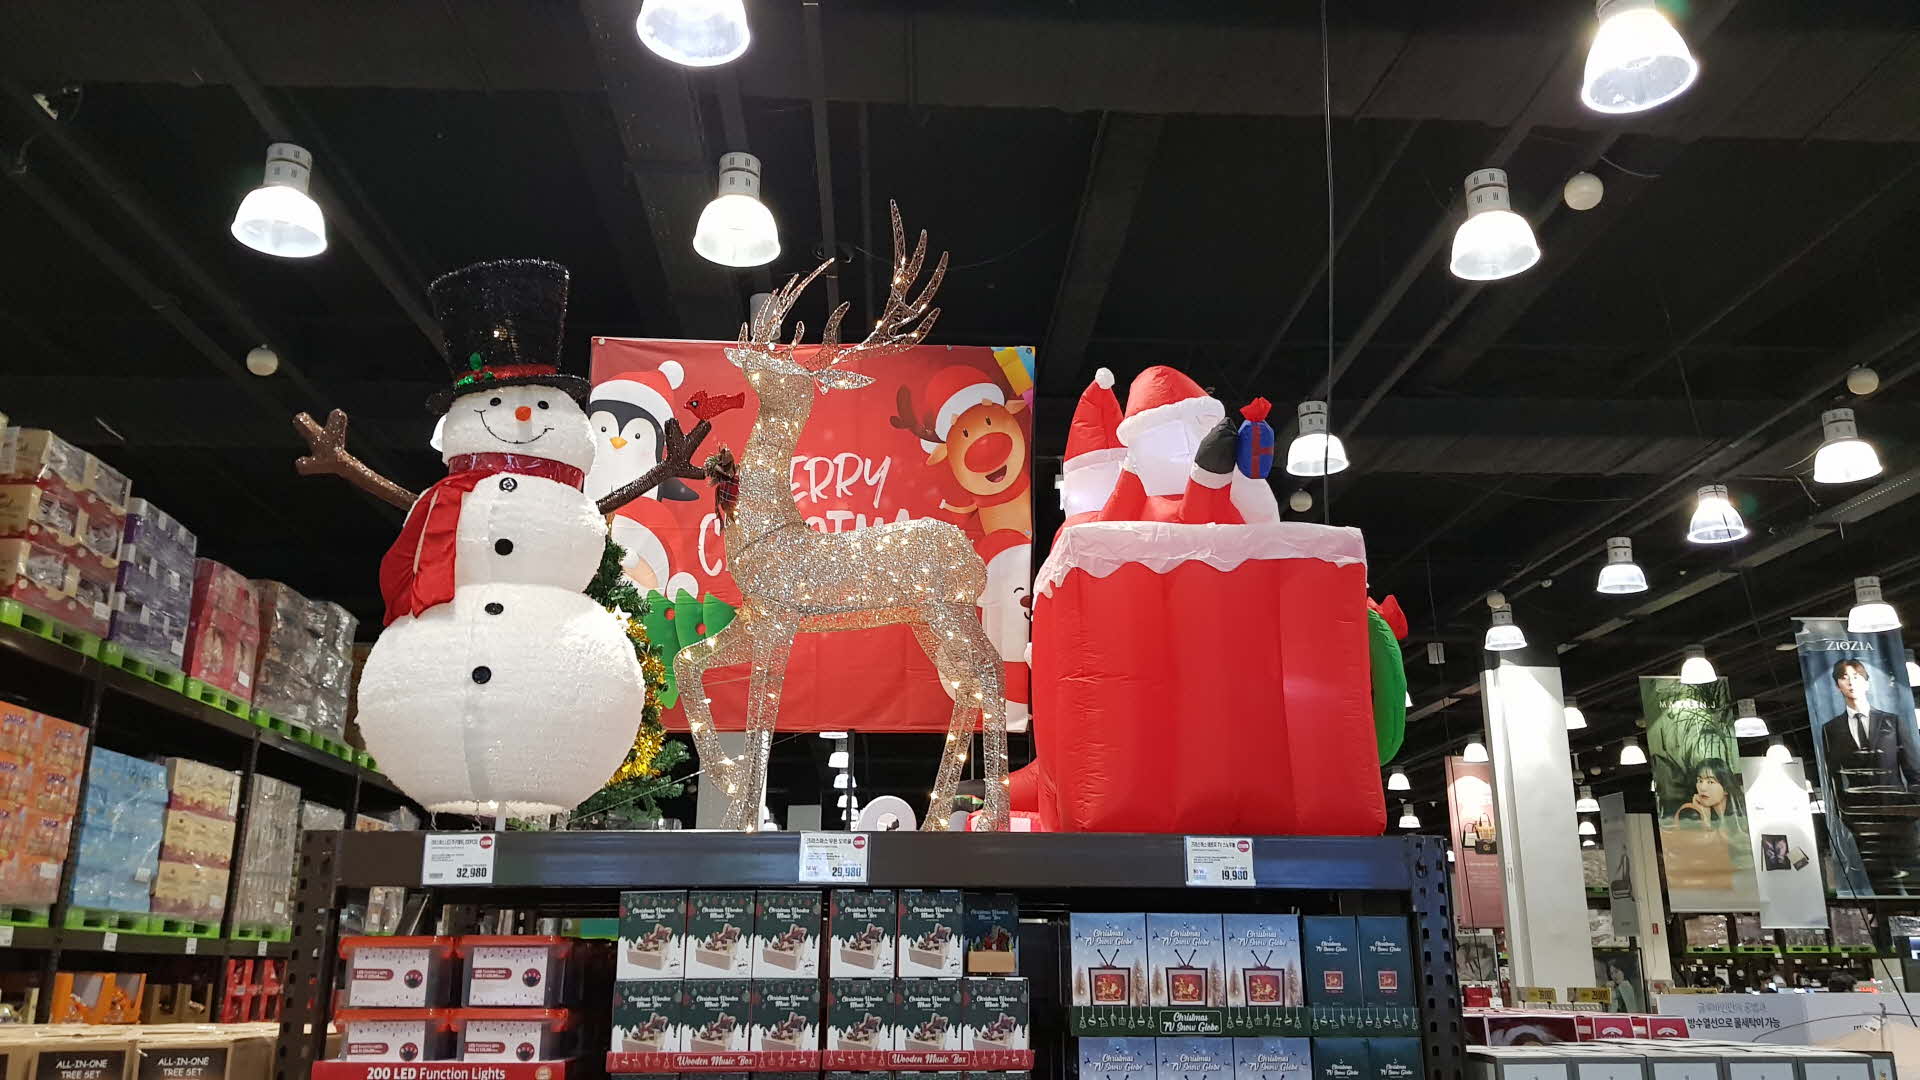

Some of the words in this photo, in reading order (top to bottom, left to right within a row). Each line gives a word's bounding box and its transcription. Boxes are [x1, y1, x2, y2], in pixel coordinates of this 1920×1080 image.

[790, 452, 892, 509] ERRY
[1826, 640, 1874, 651] ZIOZIA
[456, 867, 487, 878] 32,980
[832, 866, 861, 878] 29,980
[1221, 870, 1248, 881] 19,980
[1173, 1011, 1209, 1023] Christmas
[1163, 1021, 1176, 1033] TV
[1176, 1021, 1196, 1032] Snow
[1198, 1020, 1220, 1033] Globe
[56, 1059, 108, 1069] ALL-IN-ONE
[158, 1056, 209, 1066] ALL-IN-ONE
[676, 1056, 710, 1066] Wooden
[711, 1055, 735, 1066] Music
[739, 1055, 753, 1066] Box
[892, 1054, 923, 1064] Wooden
[925, 1054, 949, 1064] Music
[952, 1054, 967, 1064] Box
[61, 1070, 79, 1079] TREE
[81, 1070, 102, 1079] SET
[163, 1068, 182, 1077] TREE
[184, 1067, 203, 1076] SET
[367, 1067, 391, 1080] 200
[394, 1067, 416, 1080] LED
[419, 1067, 469, 1080] Function
[472, 1067, 505, 1080] Lights
